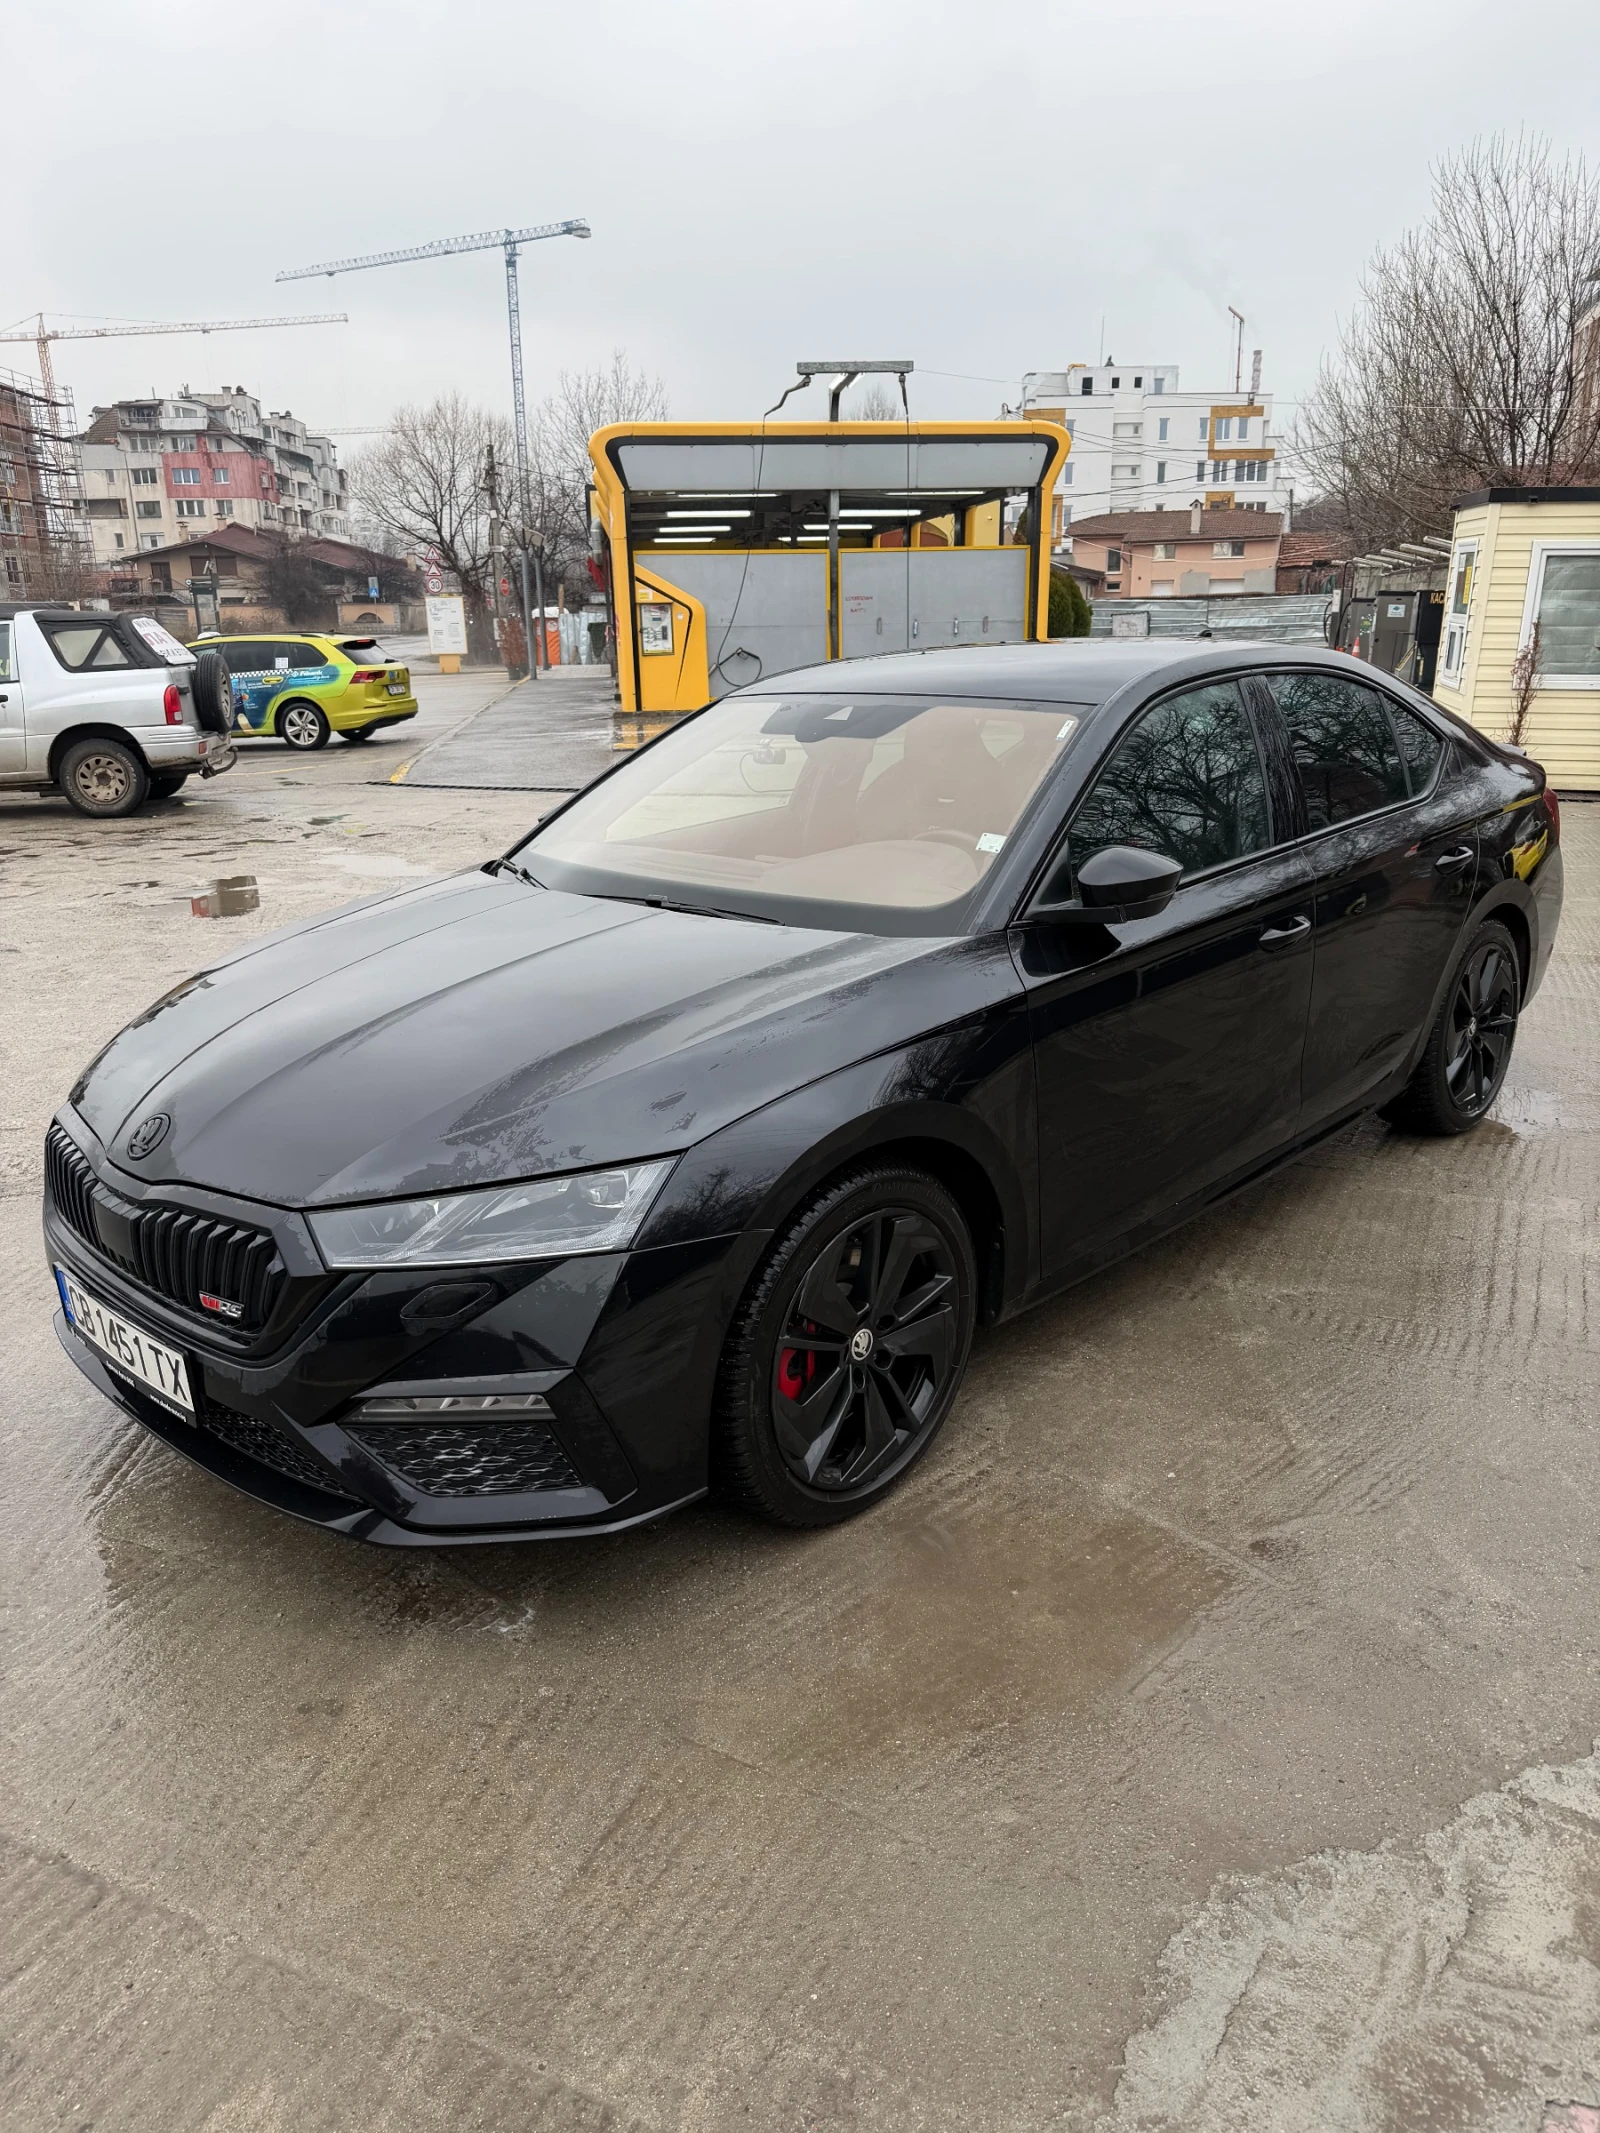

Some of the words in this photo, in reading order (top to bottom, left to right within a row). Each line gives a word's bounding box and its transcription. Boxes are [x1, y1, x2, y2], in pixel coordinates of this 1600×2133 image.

[430, 580, 441, 590] 30
[1430, 592, 1445, 604] КАС
[69, 1285, 97, 1337] CB
[96, 1308, 148, 1378] 1451
[148, 1343, 189, 1402] TX
